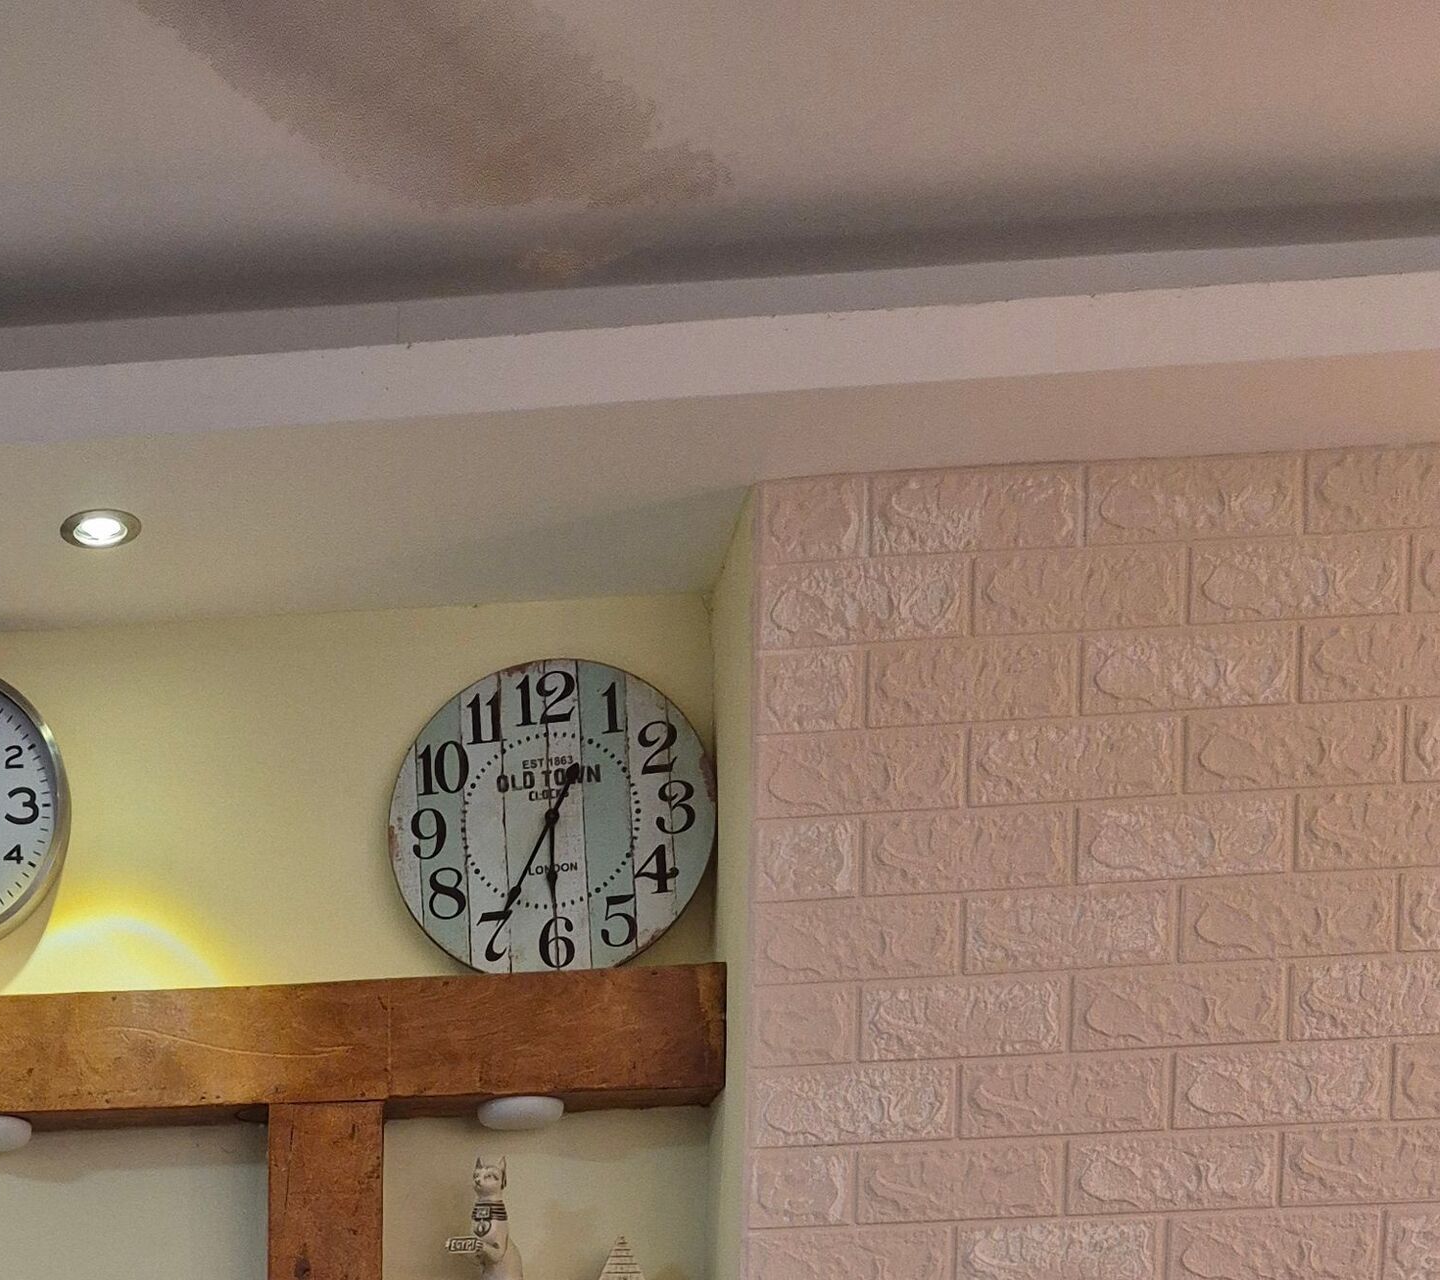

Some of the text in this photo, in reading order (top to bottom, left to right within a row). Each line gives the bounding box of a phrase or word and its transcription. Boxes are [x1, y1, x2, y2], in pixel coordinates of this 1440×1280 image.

[466, 691, 508, 745] 11
[515, 670, 576, 728] 12
[601, 681, 625, 734] 1
[4, 745, 24, 769] 2
[417, 740, 470, 796] 10
[637, 720, 678, 775] 2
[4, 787, 39, 825] 3
[497, 770, 536, 793] OLD
[655, 780, 696, 834] 3
[3, 844, 24, 865] 4
[411, 808, 447, 860] 9
[428, 867, 467, 920] 8
[529, 862, 578, 876] LONDON
[634, 844, 680, 895] 4
[476, 909, 513, 962] 7
[538, 916, 575, 969] 6
[601, 894, 638, 947] 5
